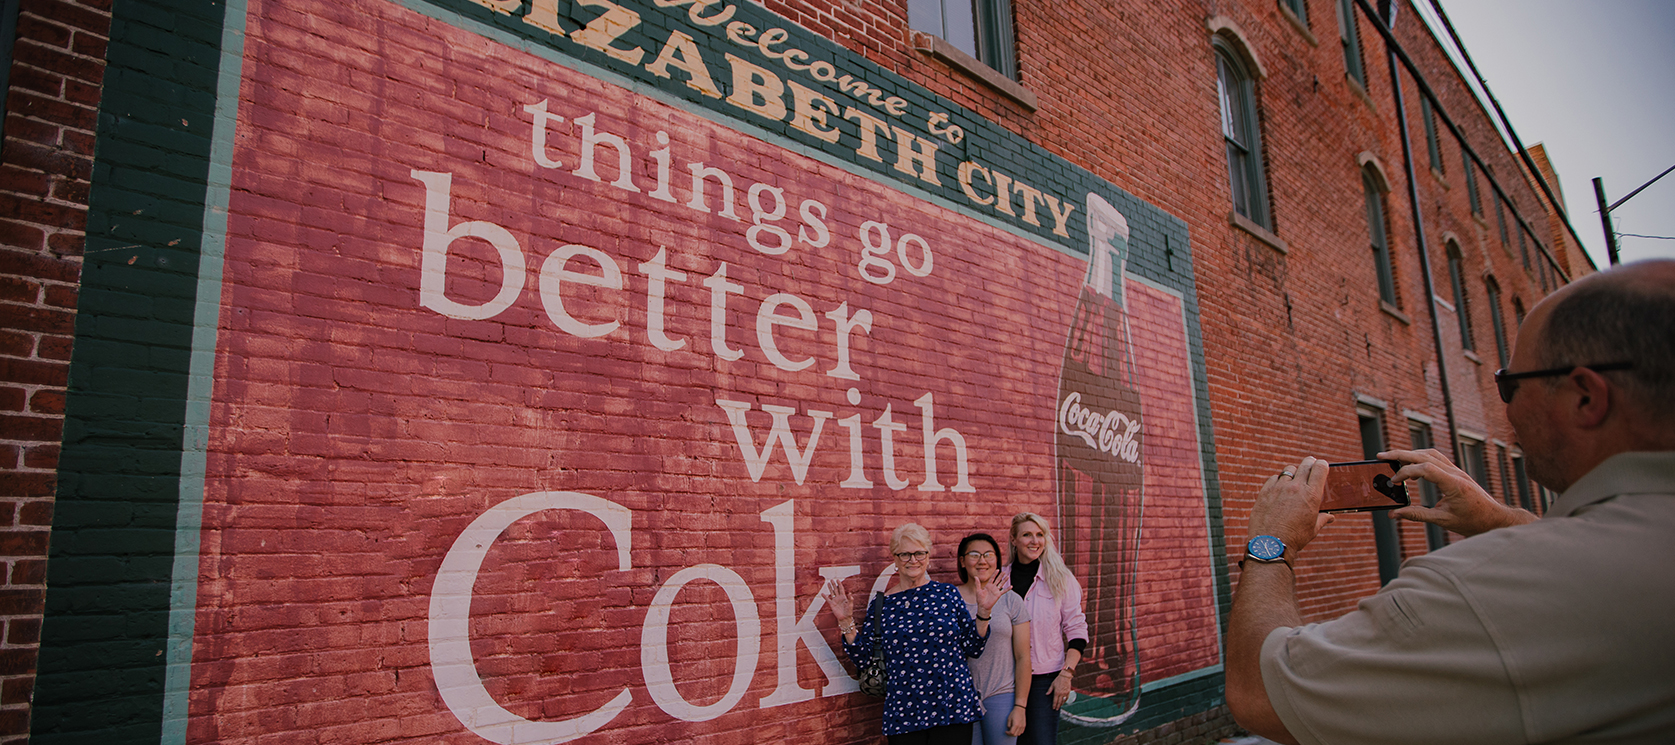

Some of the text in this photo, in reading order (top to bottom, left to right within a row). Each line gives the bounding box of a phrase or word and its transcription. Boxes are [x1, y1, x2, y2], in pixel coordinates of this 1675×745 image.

[523, 98, 934, 285] things go
[927, 111, 963, 144] to
[958, 160, 1076, 238] CITY
[410, 169, 874, 382] better
[715, 387, 976, 493] with
[428, 490, 931, 745] Cok
